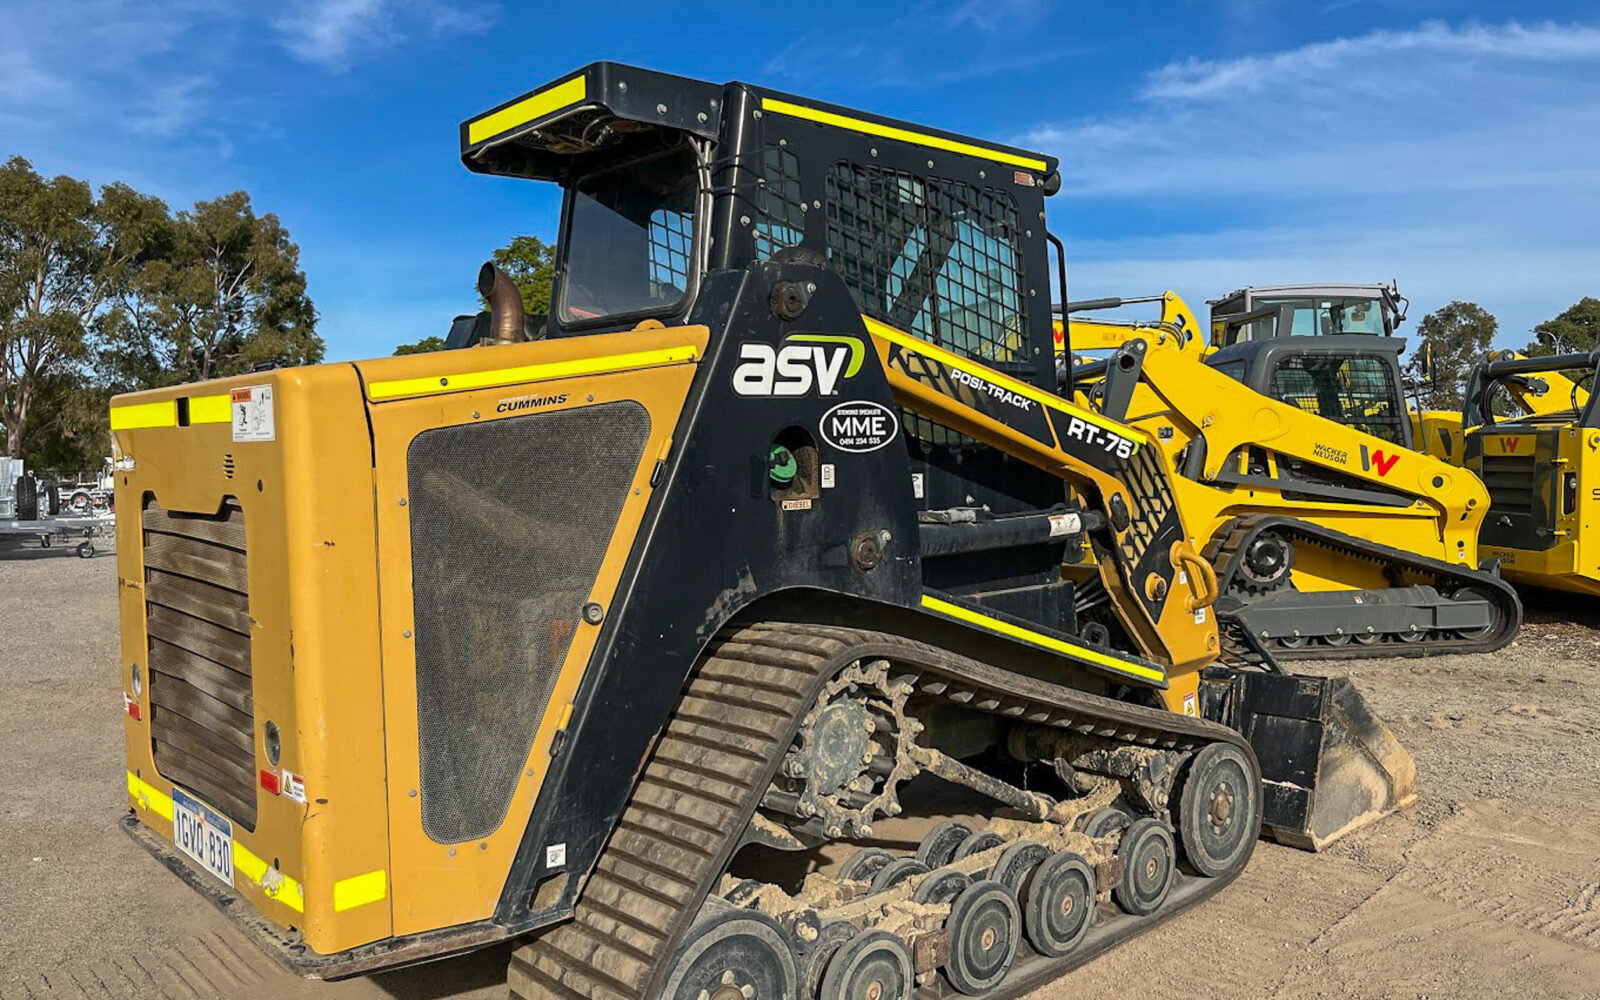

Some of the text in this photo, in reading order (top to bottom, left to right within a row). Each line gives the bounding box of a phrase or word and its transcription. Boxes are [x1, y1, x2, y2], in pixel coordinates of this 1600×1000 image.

[950, 368, 1030, 411] POSI-TRACK
[496, 393, 568, 413] CUMMINS
[832, 416, 886, 437] MME
[1067, 417, 1132, 459] RT-75
[1313, 449, 1347, 465] NEUSON
[1314, 442, 1347, 458] WACKER
[788, 501, 810, 509] DIESEL
